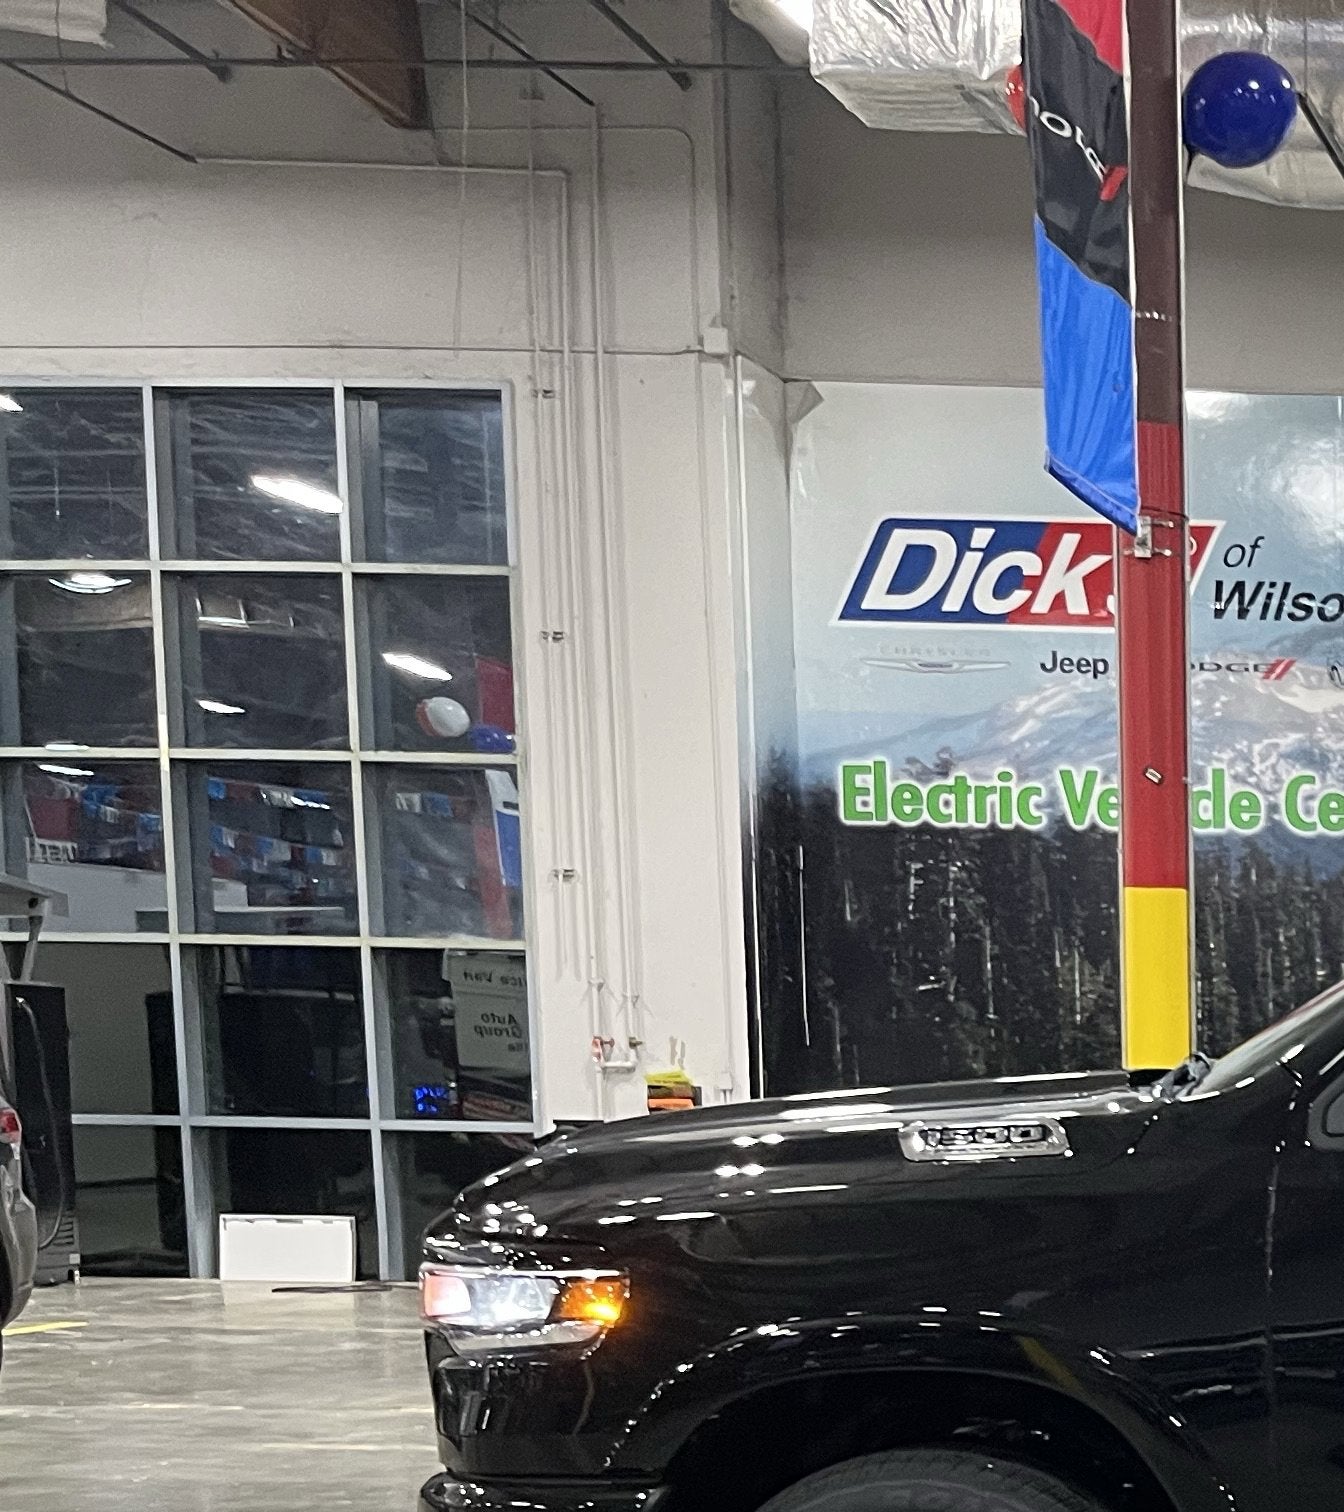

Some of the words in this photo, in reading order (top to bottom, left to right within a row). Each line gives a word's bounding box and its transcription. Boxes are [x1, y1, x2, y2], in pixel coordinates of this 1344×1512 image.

[861, 528, 1115, 616] Dick
[1223, 536, 1265, 568] of
[1039, 650, 1110, 679] Jeep
[1191, 661, 1271, 673] DGE
[843, 761, 1043, 826] Electric
[1059, 769, 1262, 831] Vecle
